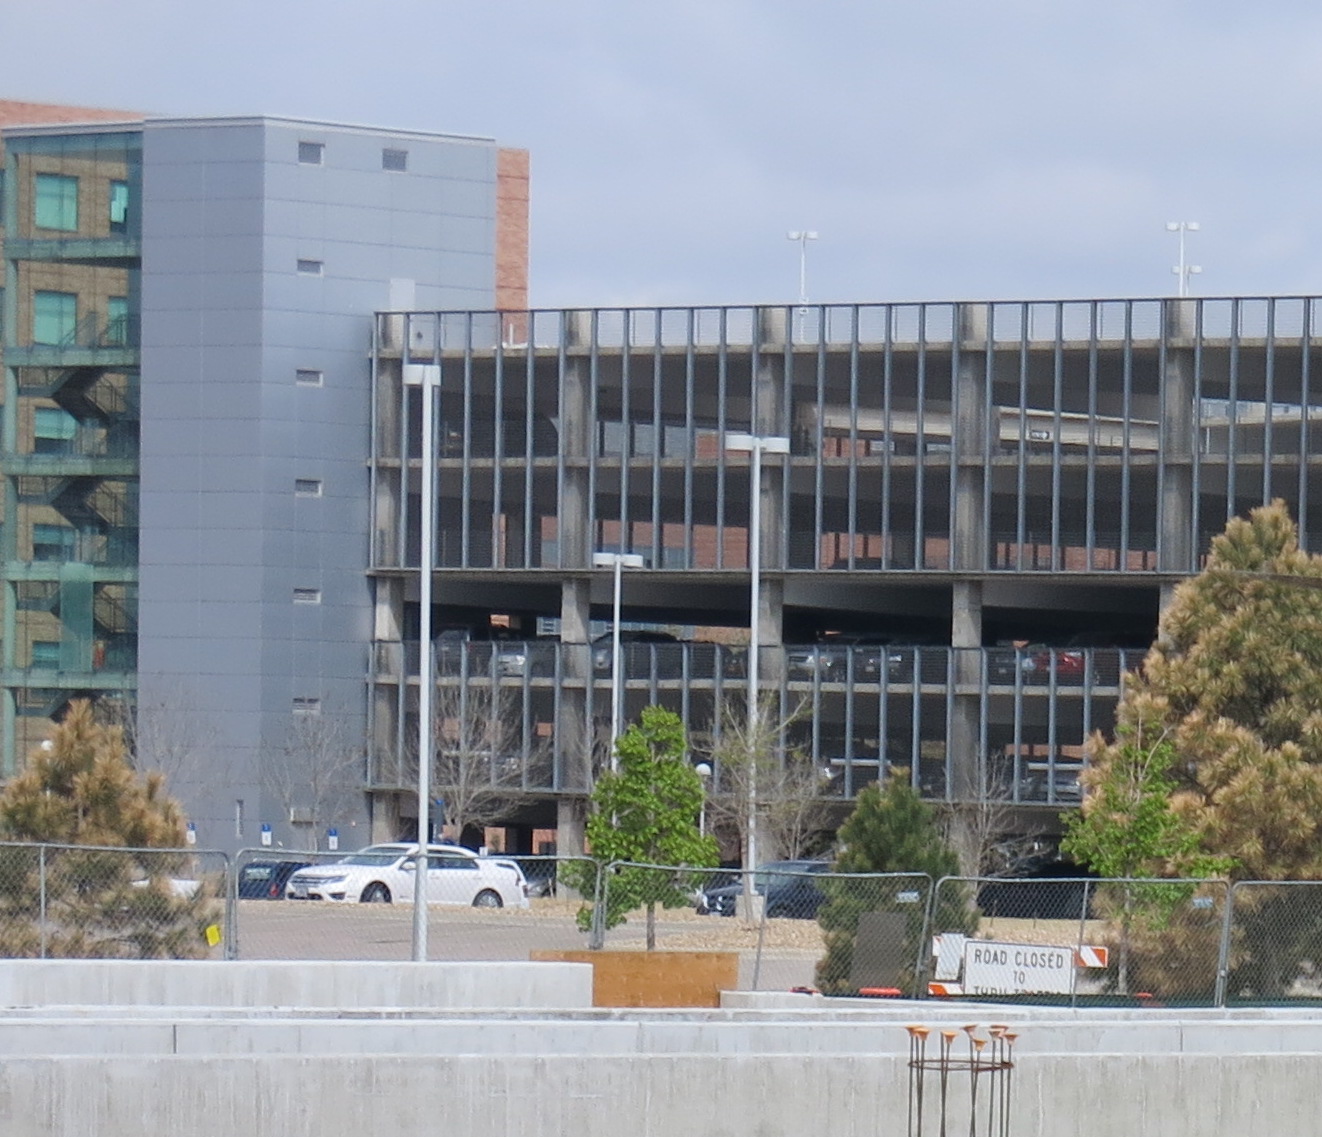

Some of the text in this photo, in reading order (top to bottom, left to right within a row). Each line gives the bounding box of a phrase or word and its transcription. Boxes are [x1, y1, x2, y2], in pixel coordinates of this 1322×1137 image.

[974, 949, 1063, 969] ROAD CLOSED
[1013, 970, 1026, 985] TO
